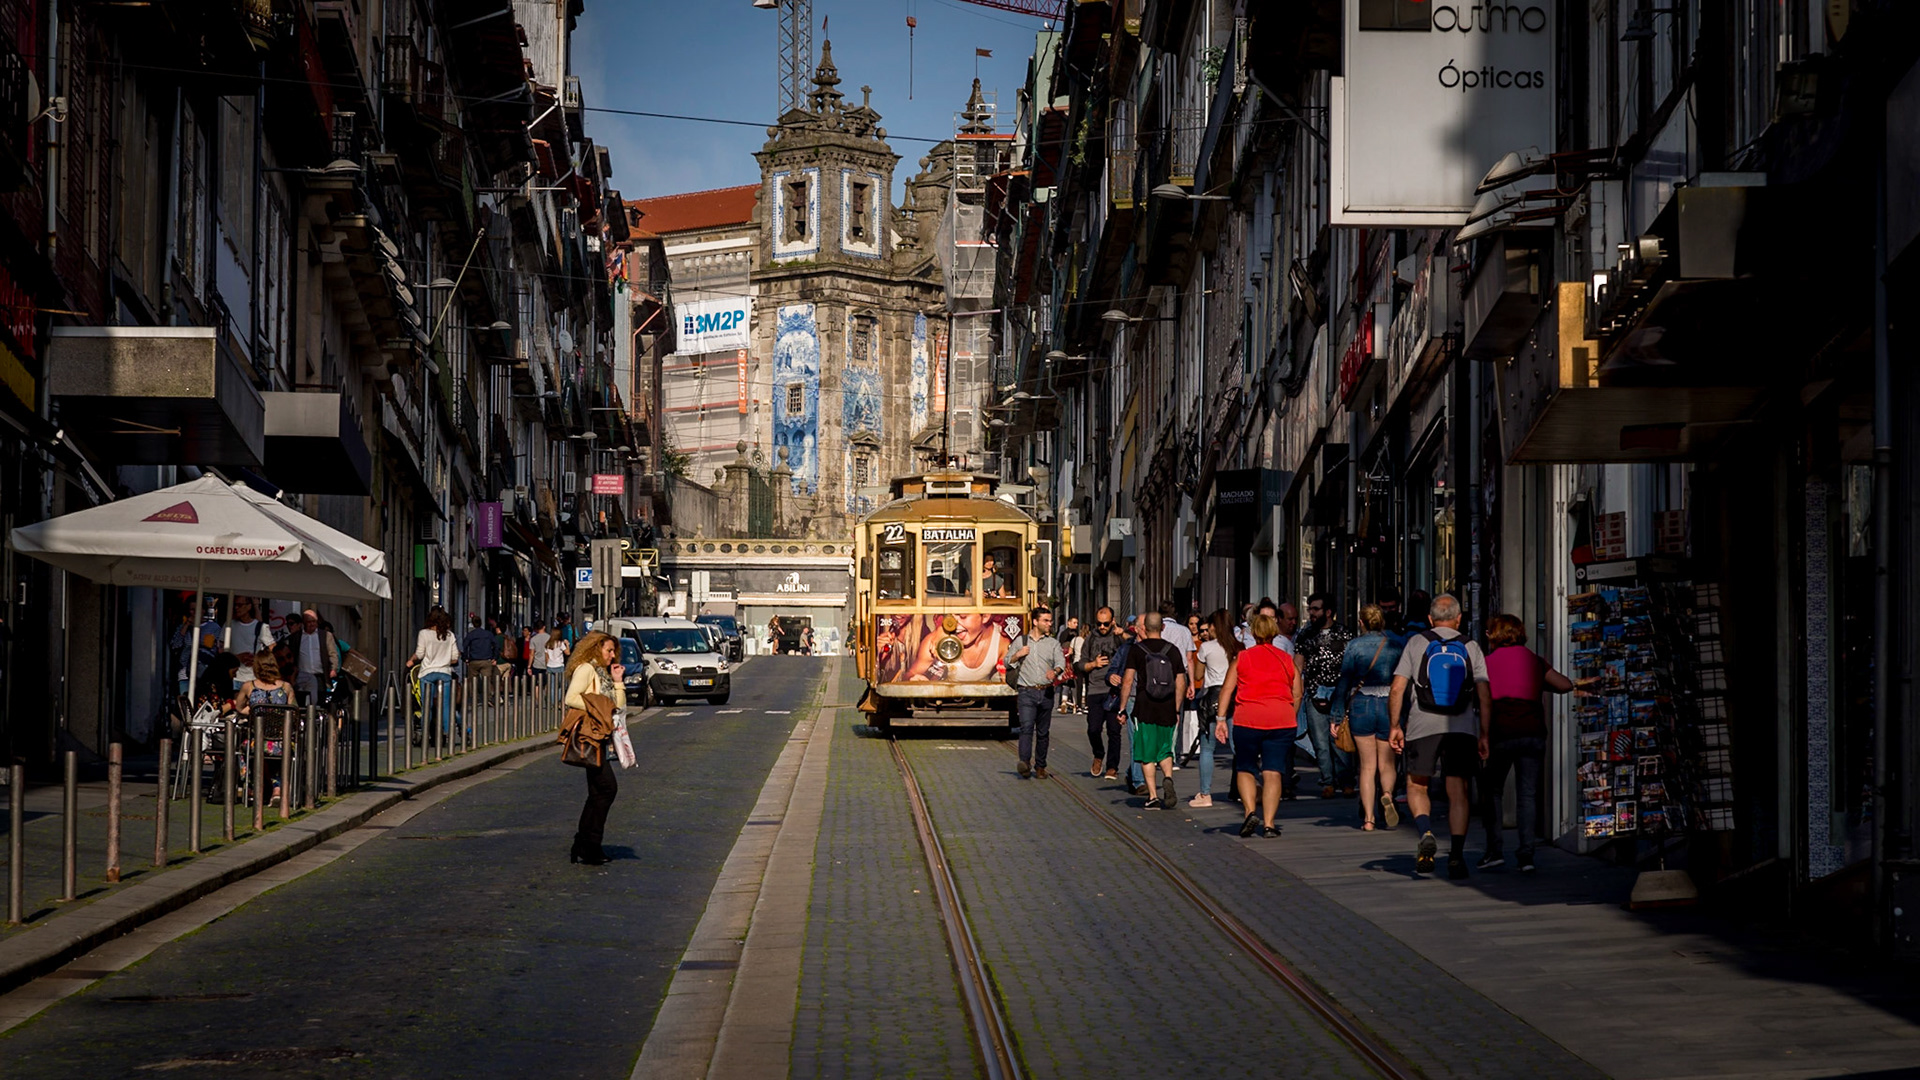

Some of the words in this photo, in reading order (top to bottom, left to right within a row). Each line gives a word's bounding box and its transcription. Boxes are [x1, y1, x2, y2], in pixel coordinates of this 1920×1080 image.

[1439, 59, 1545, 93] Ópticas
[1220, 490, 1254, 498] MACHADO
[885, 525, 904, 541] 22
[923, 529, 975, 540] BATALHA
[196, 545, 204, 554] O
[204, 545, 226, 555] CAFÉ
[227, 547, 239, 555] DA
[240, 547, 257, 556] SUA
[258, 548, 279, 557] VIDA
[776, 583, 810, 592] ABILINI
[880, 618, 893, 626] 205
